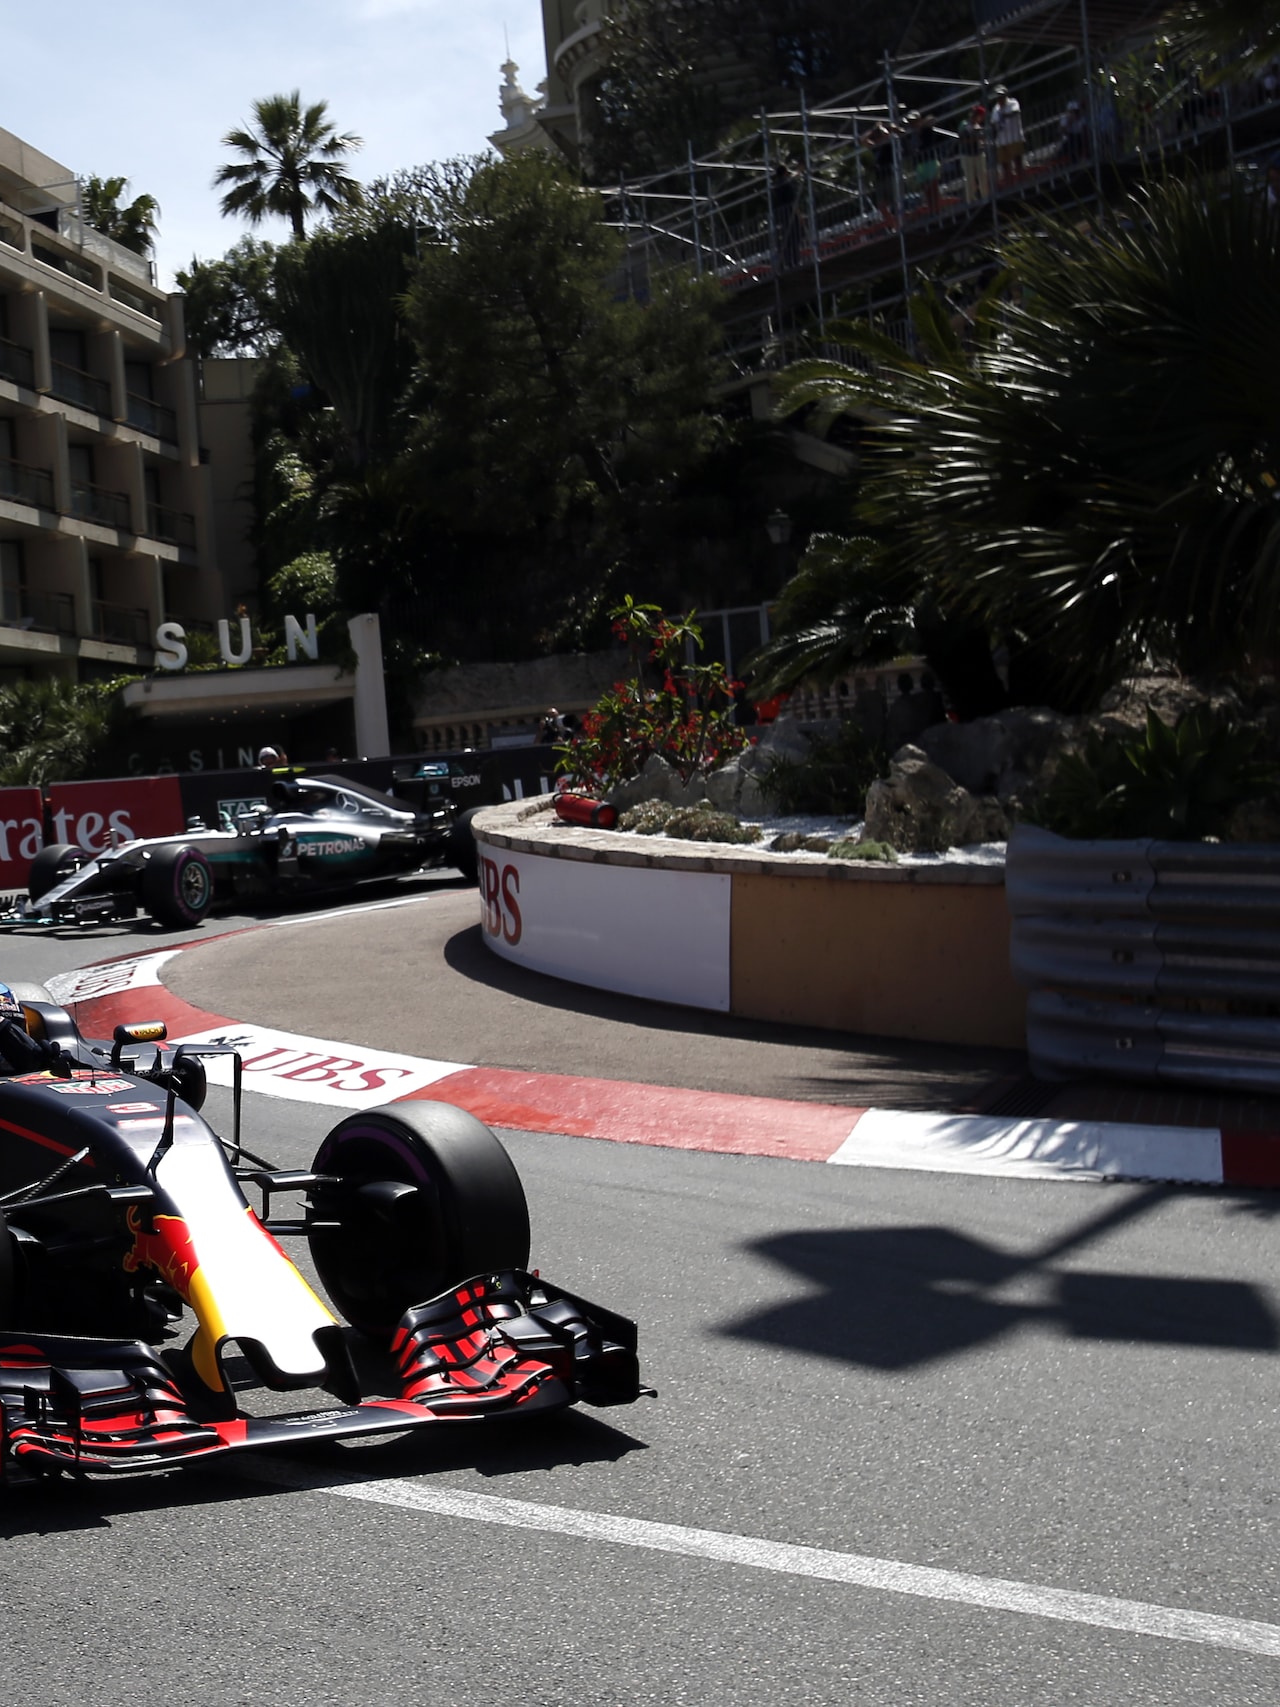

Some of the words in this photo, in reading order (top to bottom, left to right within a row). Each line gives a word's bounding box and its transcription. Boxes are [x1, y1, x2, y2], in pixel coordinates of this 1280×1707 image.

[155, 613, 319, 670] SUN
[127, 746, 256, 776] CASIN
[451, 774, 482, 789] EPSON
[297, 839, 367, 857] PETRONAS
[241, 1047, 415, 1091] UBS
[105, 1102, 160, 1114] 3
